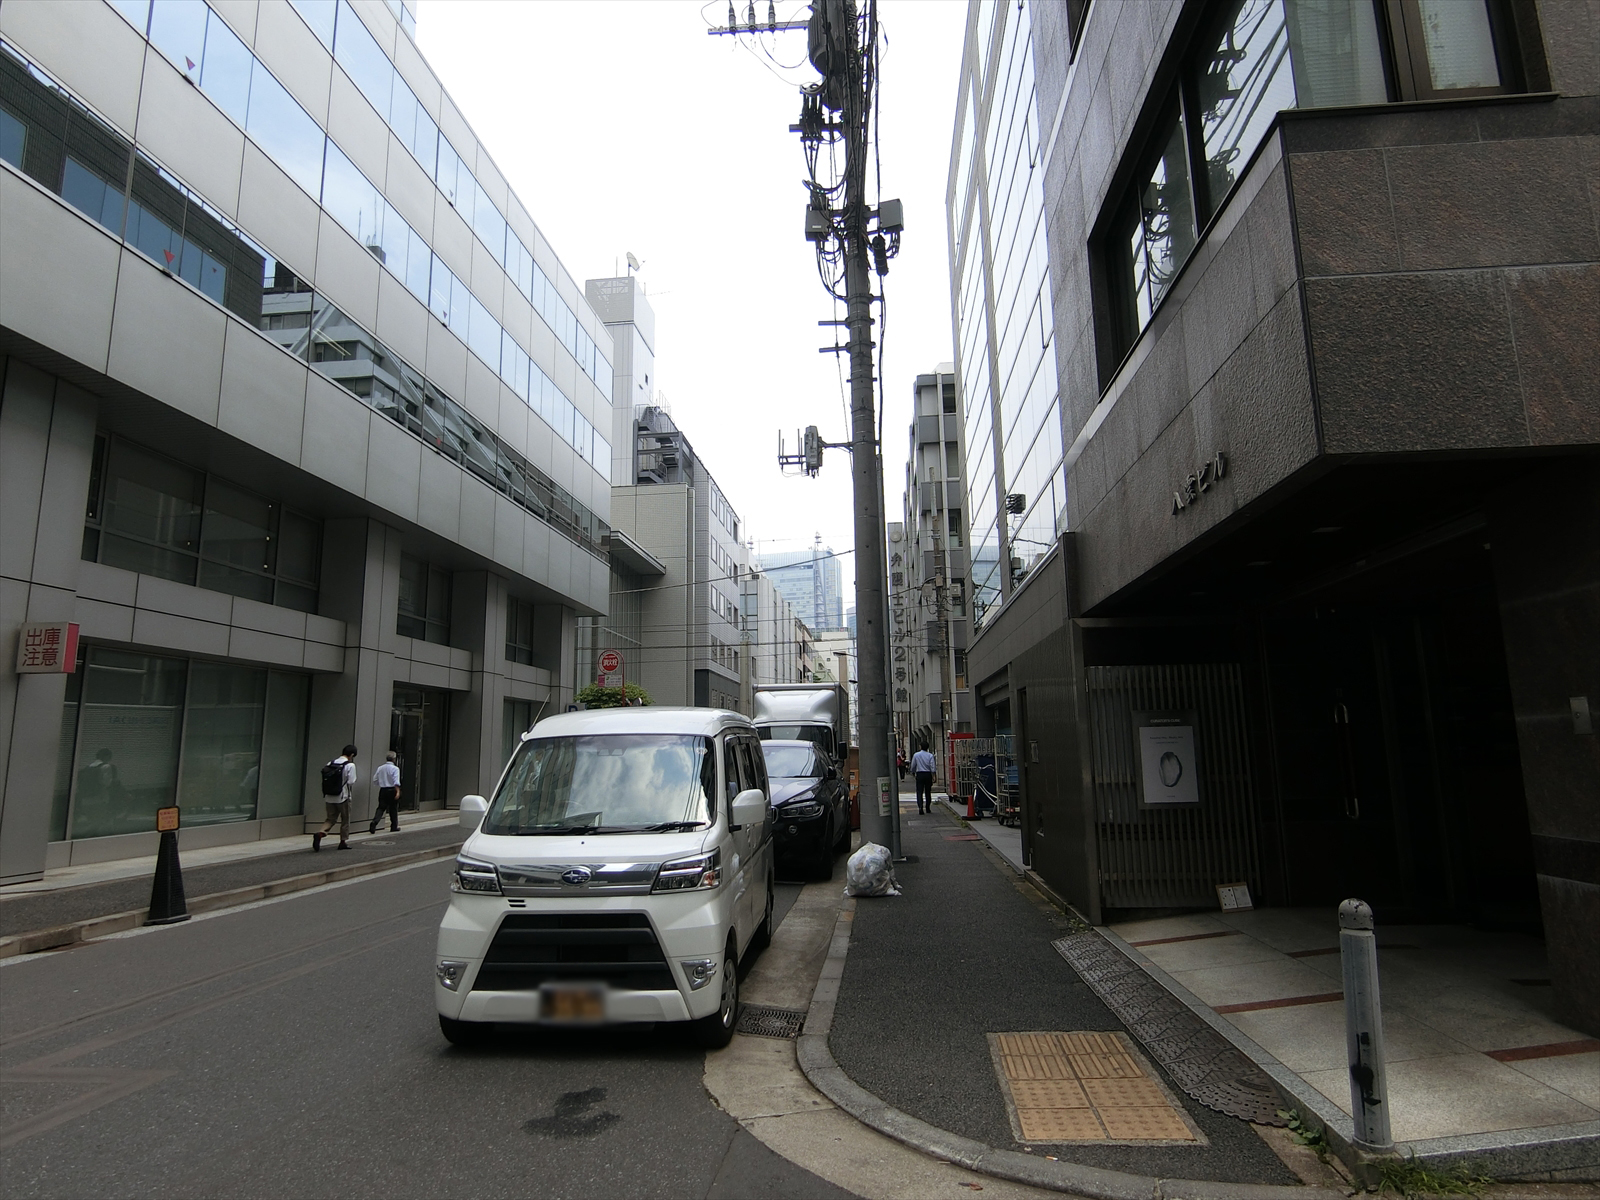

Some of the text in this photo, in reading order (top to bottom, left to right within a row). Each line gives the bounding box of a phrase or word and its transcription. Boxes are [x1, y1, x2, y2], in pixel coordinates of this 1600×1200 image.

[25, 627, 61, 647] 出庫
[890, 552, 908, 703] 弁護士ビル2号館
[22, 646, 59, 667] 注意
[603, 658, 617, 667] 消火栓
